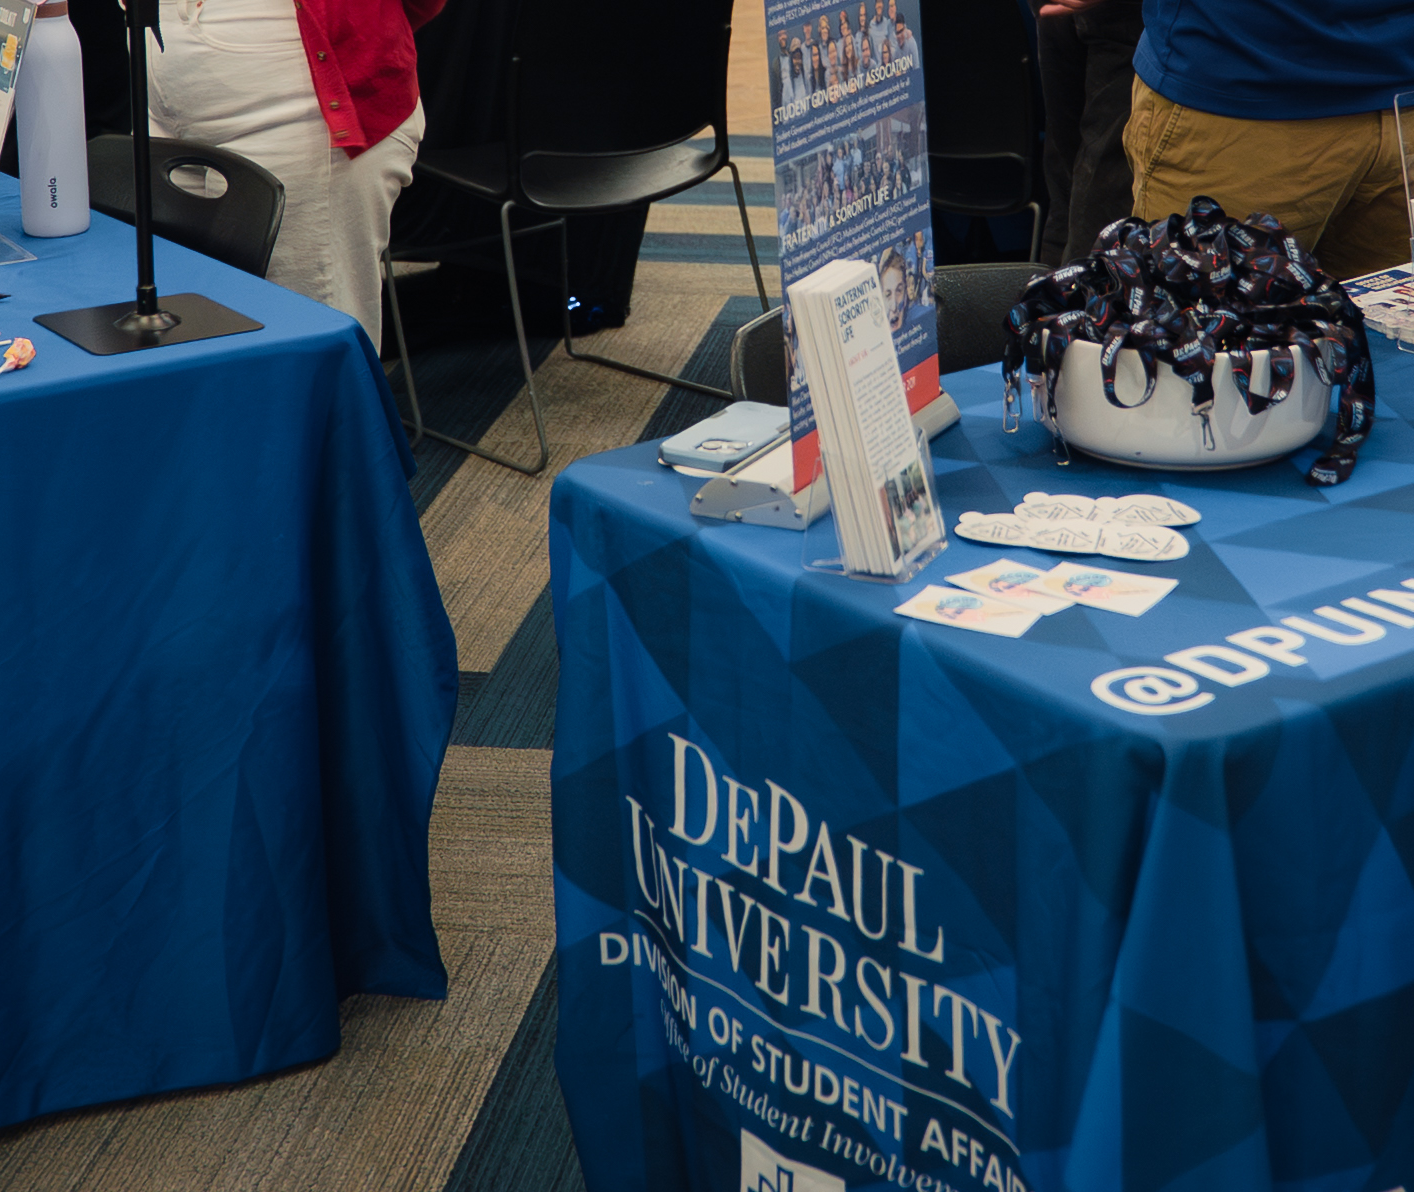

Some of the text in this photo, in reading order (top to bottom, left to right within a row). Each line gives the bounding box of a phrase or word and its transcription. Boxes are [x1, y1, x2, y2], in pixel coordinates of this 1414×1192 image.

[774, 54, 913, 125] STUDENT GOVERNMENT ASSOCIATION
[48, 177, 58, 209] owala
[835, 192, 873, 224] SORORITY
[873, 186, 890, 205] LIFE
[668, 732, 944, 964] DEPAUL
[626, 795, 1022, 1120] UNIVERSITY
[599, 932, 697, 1030] DIVISION
[708, 1006, 743, 1055] OF
[751, 1034, 908, 1141] STUDENT
[692, 1052, 719, 1089] of
[720, 1066, 813, 1143] Student
